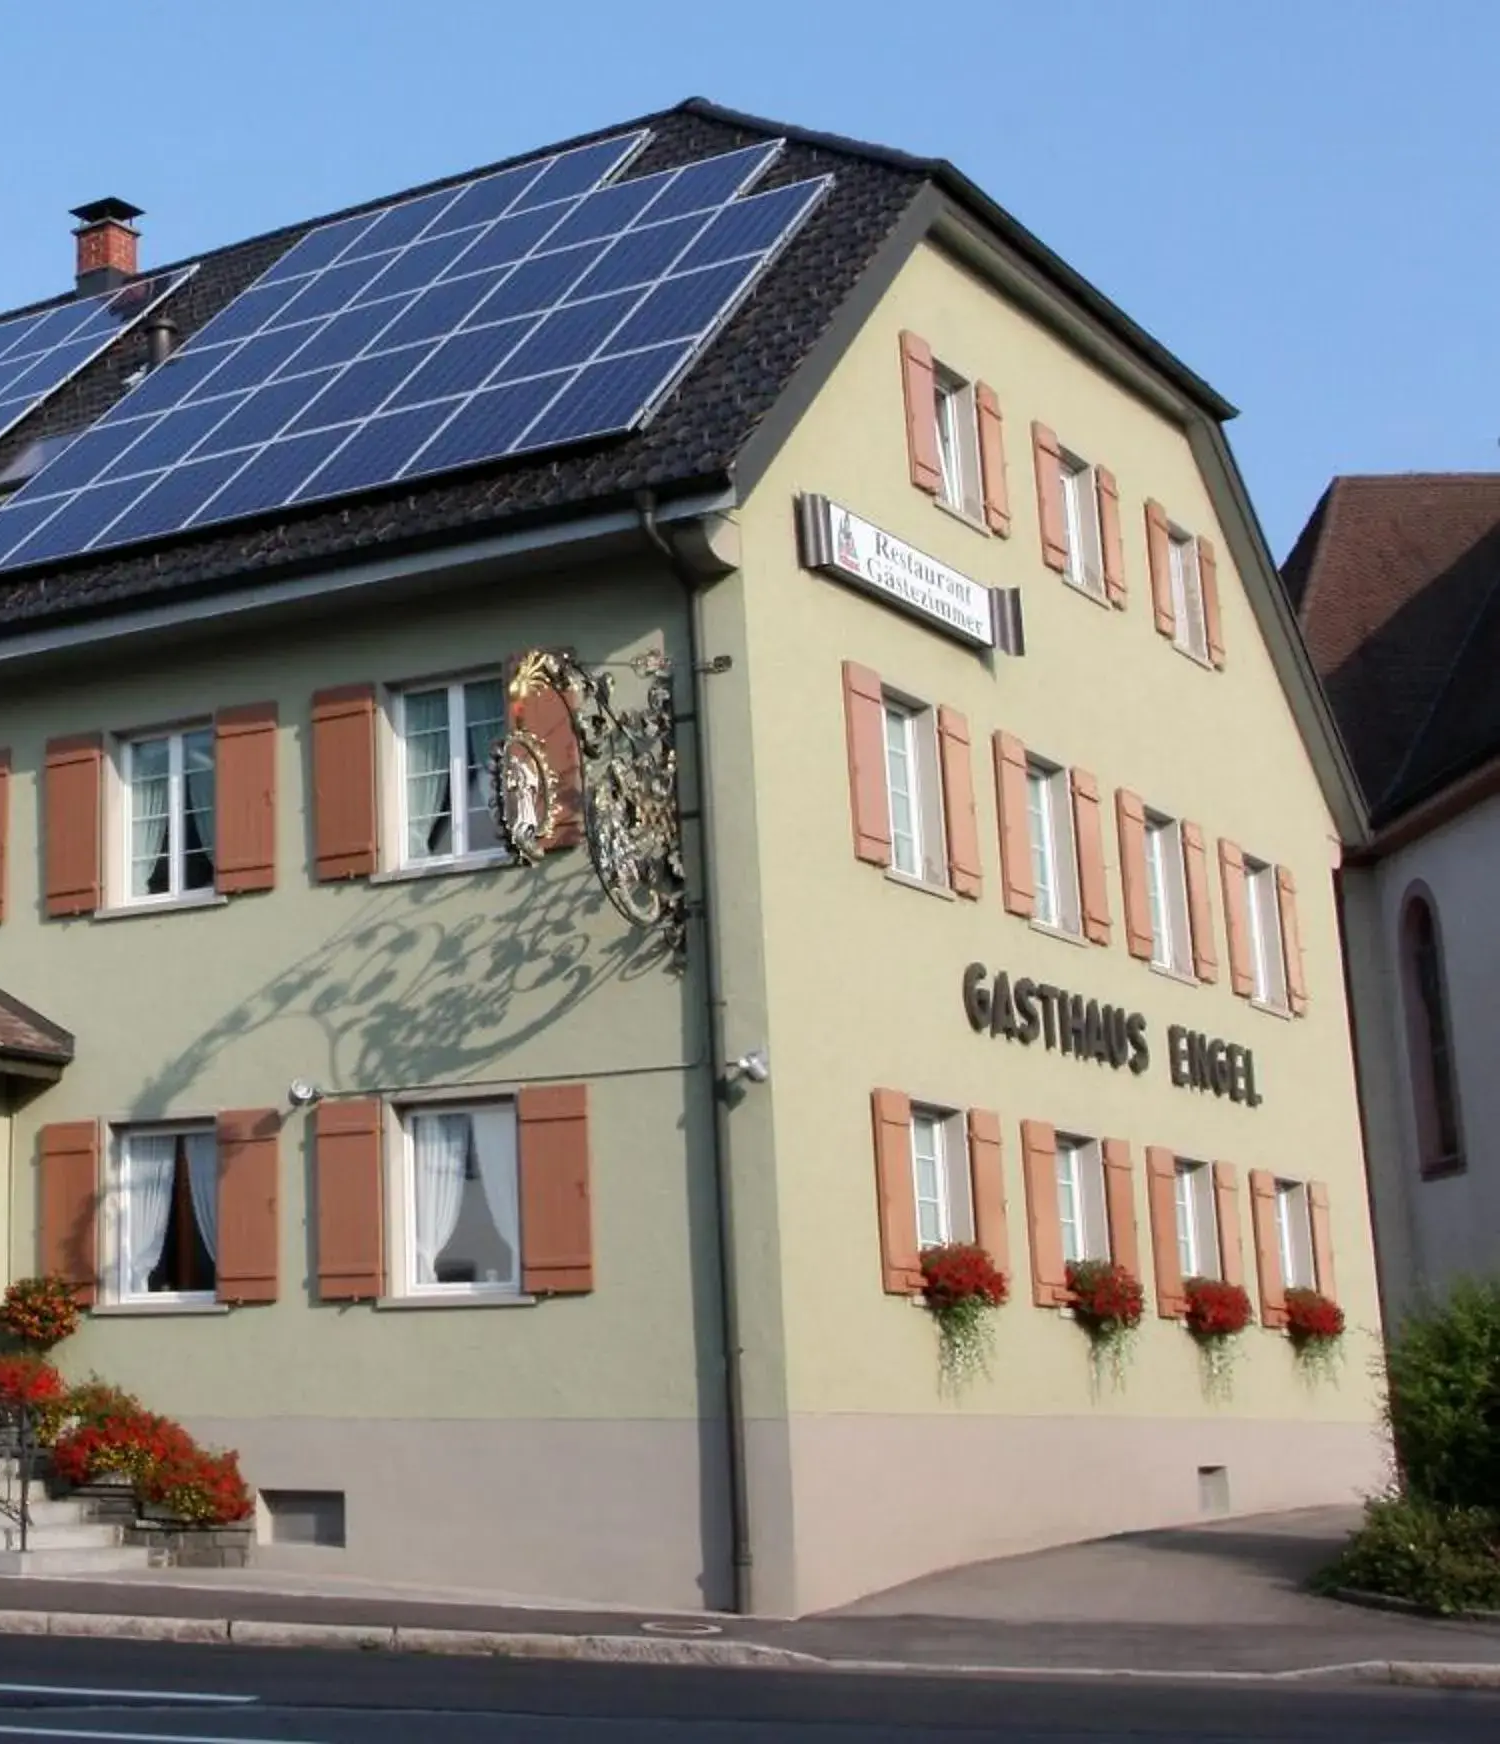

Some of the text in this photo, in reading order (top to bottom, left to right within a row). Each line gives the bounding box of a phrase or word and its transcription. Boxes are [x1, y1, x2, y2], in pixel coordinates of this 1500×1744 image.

[866, 557, 984, 635] Gästezimmer
[873, 531, 973, 606] Restaurant
[962, 961, 1262, 1108] GASTHAUS ENGEL
